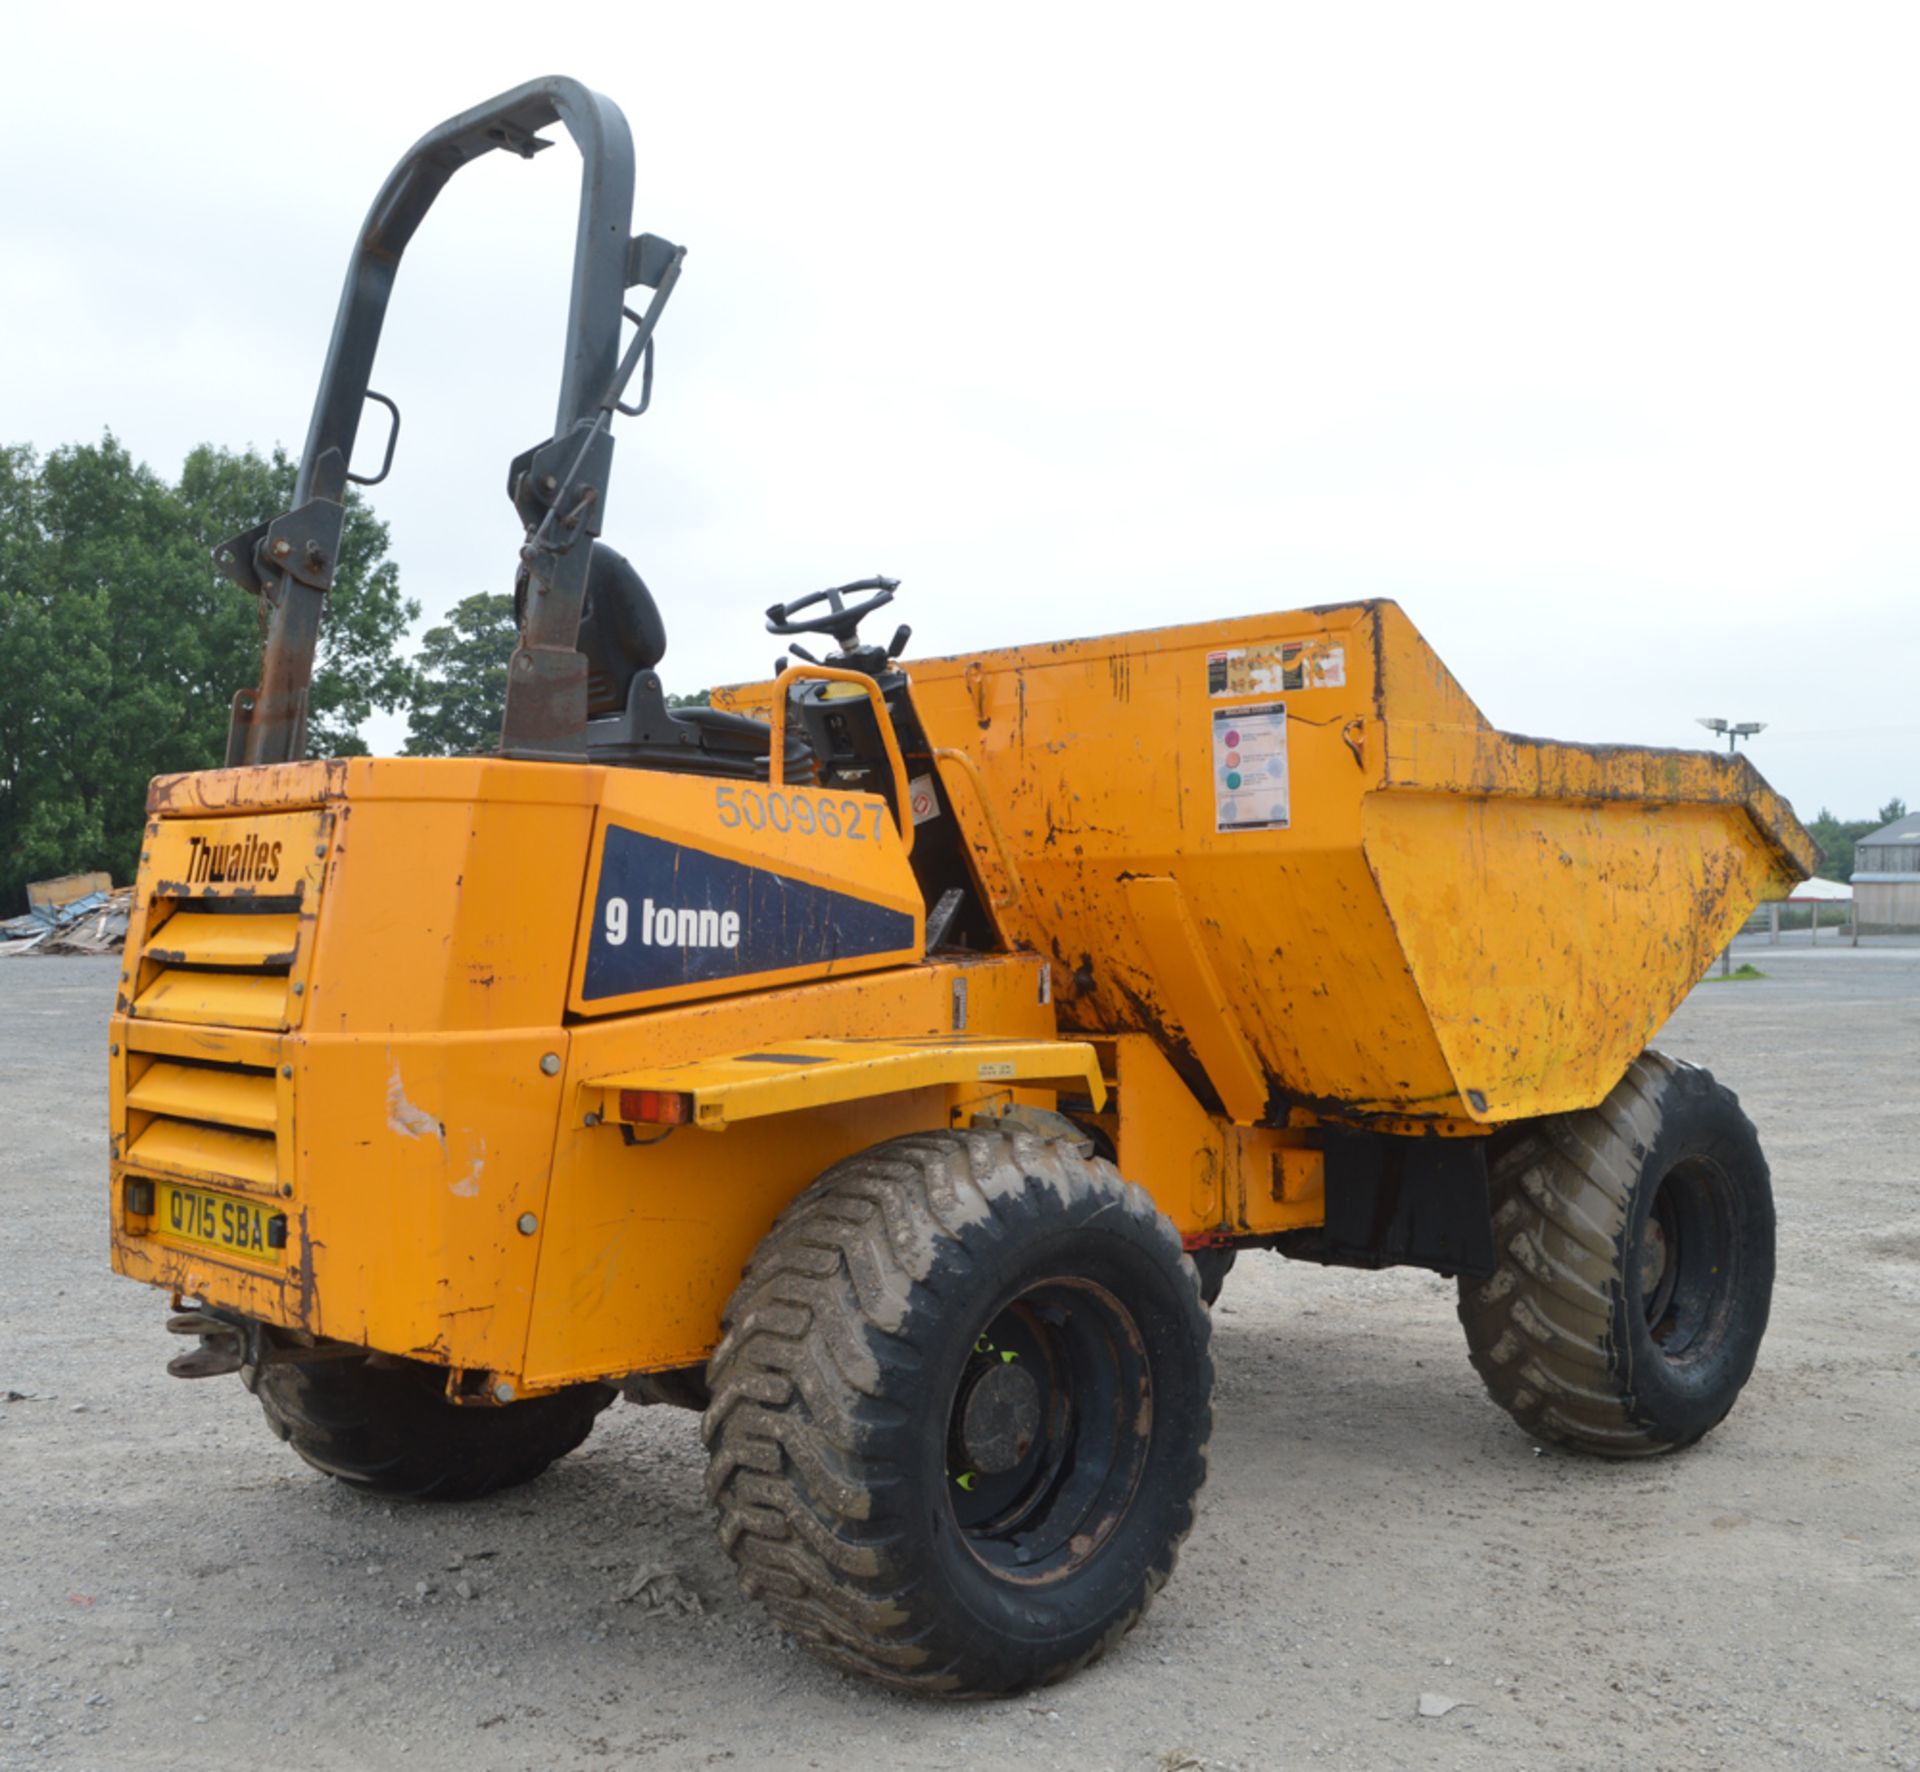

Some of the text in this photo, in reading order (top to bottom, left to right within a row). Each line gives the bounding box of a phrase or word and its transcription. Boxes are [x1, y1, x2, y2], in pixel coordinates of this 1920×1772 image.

[715, 786, 884, 841] 5009627
[186, 833, 282, 883] Thwaites
[605, 897, 740, 949] 9 tonne
[171, 1189, 263, 1252] Q715 SBA
